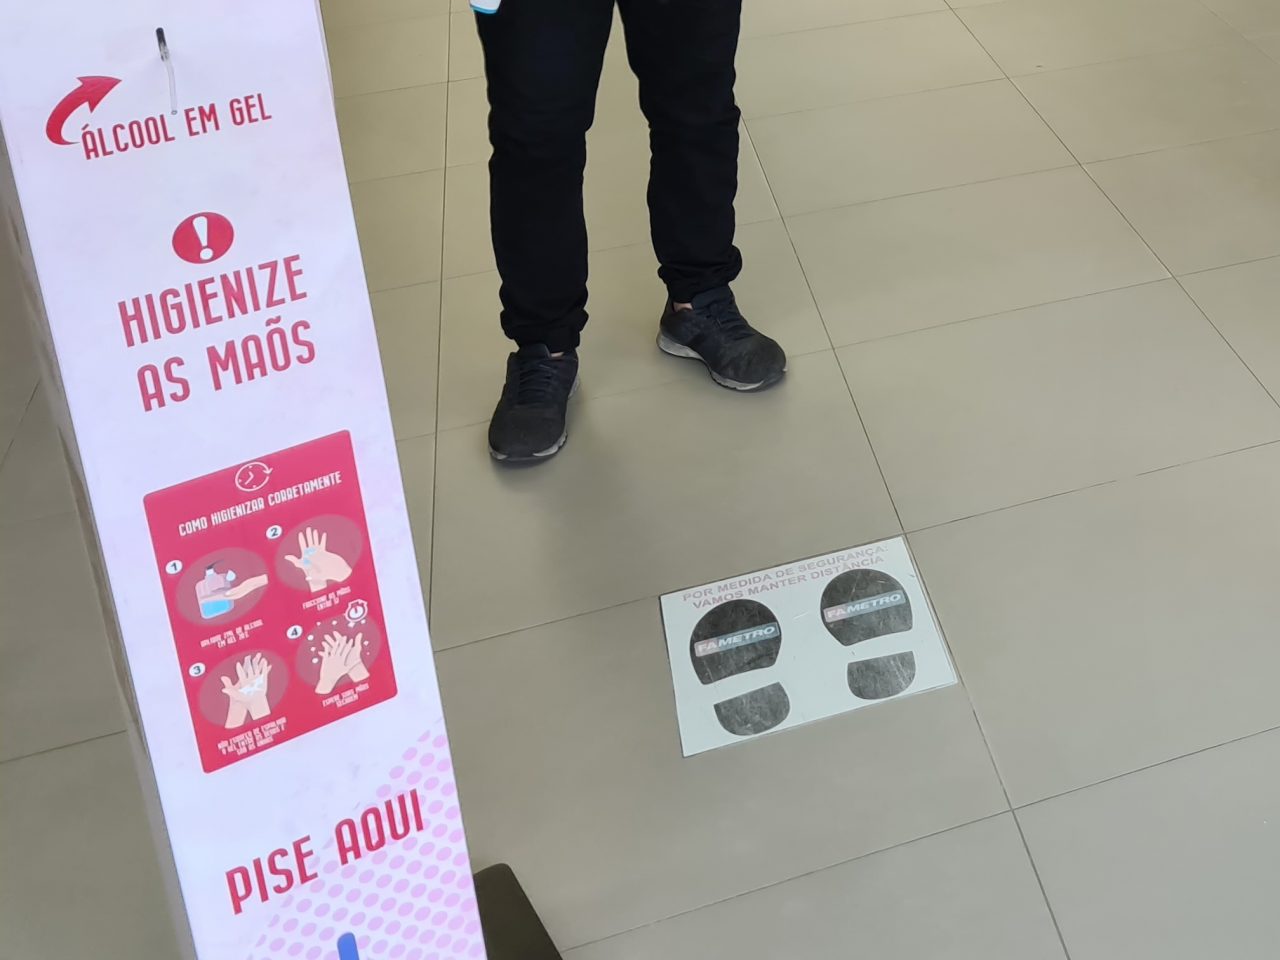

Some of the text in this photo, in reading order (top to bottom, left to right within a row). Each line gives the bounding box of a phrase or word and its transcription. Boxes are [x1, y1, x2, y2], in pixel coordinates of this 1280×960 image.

[80, 92, 272, 161] ÁLCOOL EM GEL
[117, 253, 308, 348] HIGIENIZE
[136, 315, 316, 412] AS MAÕS
[178, 470, 342, 537] COMO HIGIENIZAR CORRETAMENTE
[682, 587, 713, 602] POR
[717, 573, 772, 593] MEDIDA
[775, 567, 795, 579] DE
[692, 555, 884, 609] VAMOS MANTER DISTÂNCIA
[825, 593, 901, 620] FAMETRO
[697, 625, 776, 652] FAMETRO
[225, 788, 424, 915] PISE AQUI
